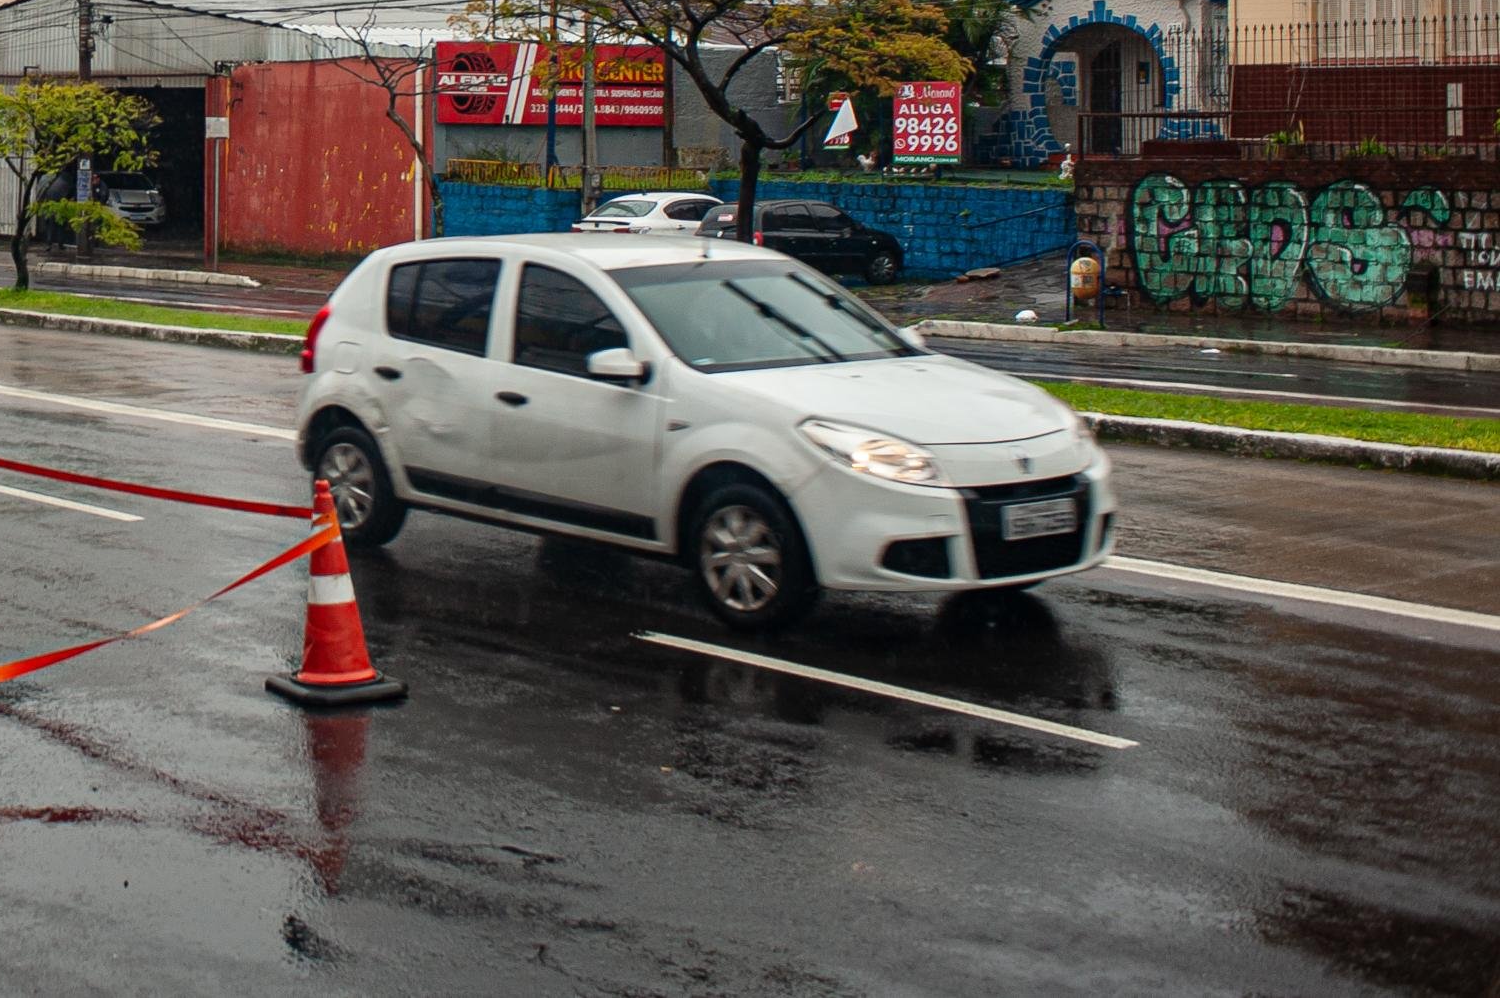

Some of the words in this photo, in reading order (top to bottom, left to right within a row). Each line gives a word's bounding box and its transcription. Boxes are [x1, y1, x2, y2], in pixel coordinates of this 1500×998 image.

[900, 103, 954, 115] ALUGA
[894, 117, 959, 134] 98426
[907, 135, 958, 152] 9996
